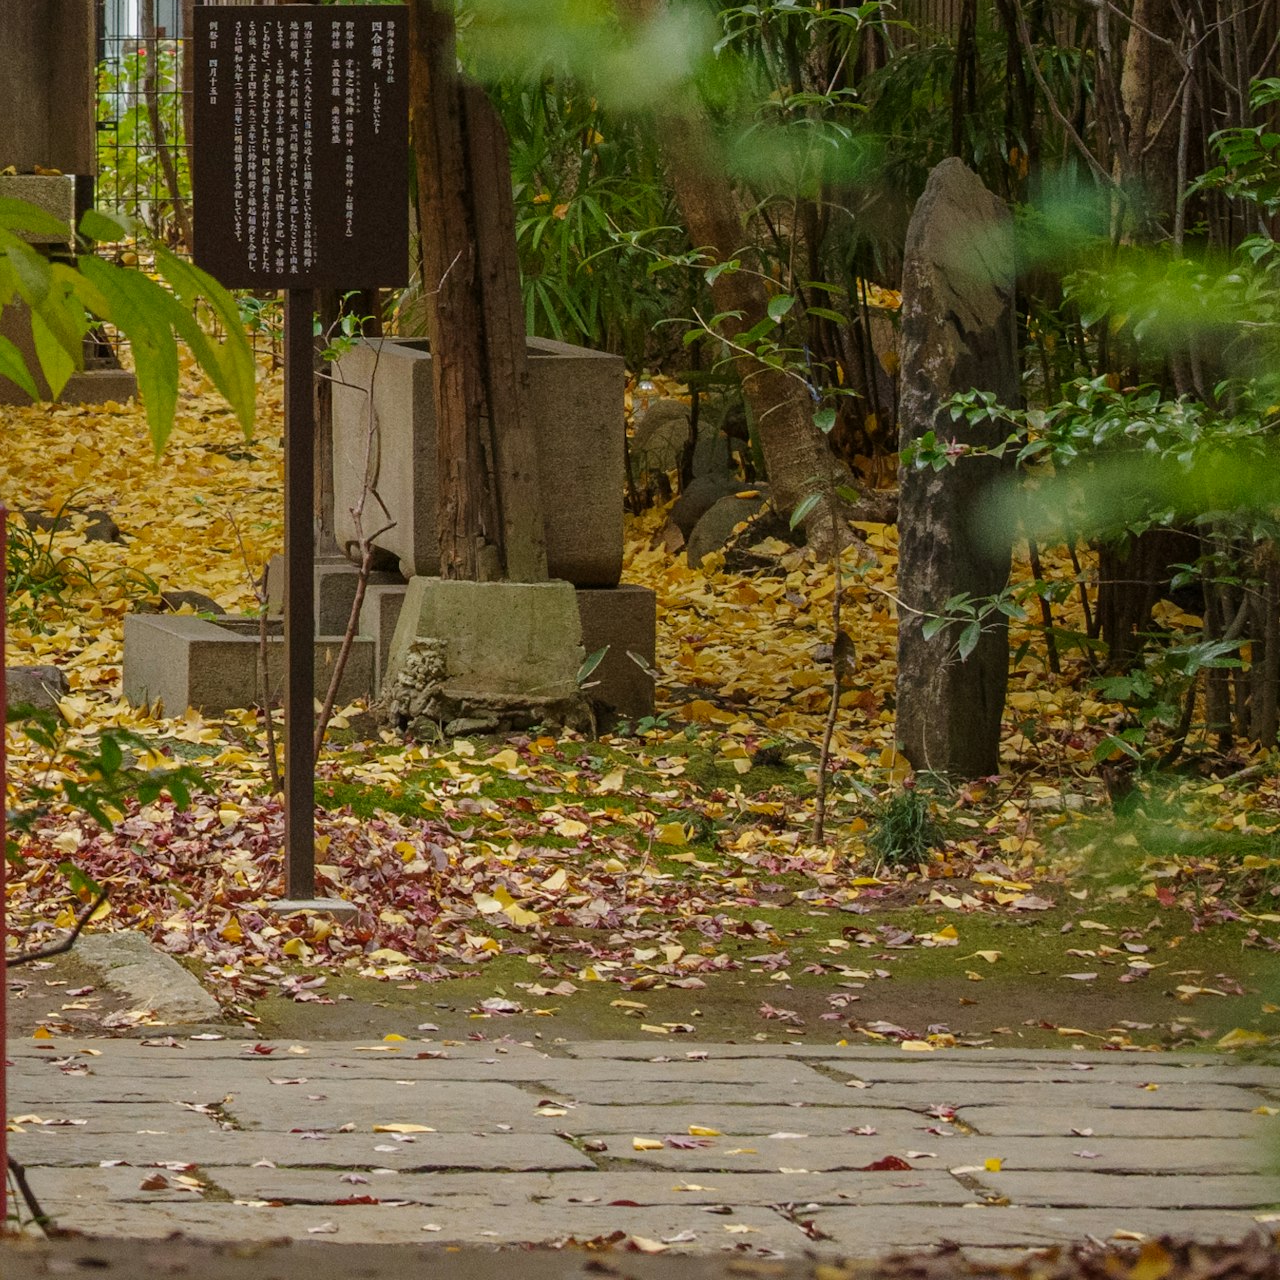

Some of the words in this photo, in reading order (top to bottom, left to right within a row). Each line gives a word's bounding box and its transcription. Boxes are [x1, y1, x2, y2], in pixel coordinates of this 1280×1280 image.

[209, 21, 219, 49] 例祭日
[331, 21, 341, 49] 御神徳
[345, 21, 355, 49] 御祭神
[371, 21, 384, 70] 四合稲荷
[386, 21, 396, 84] 勝海舟ゆかりの社
[209, 59, 219, 105] 四月十五日
[331, 58, 341, 97] 五穀豊穣
[331, 105, 341, 144] 商売繁盛
[372, 82, 381, 134] しあわせいなり
